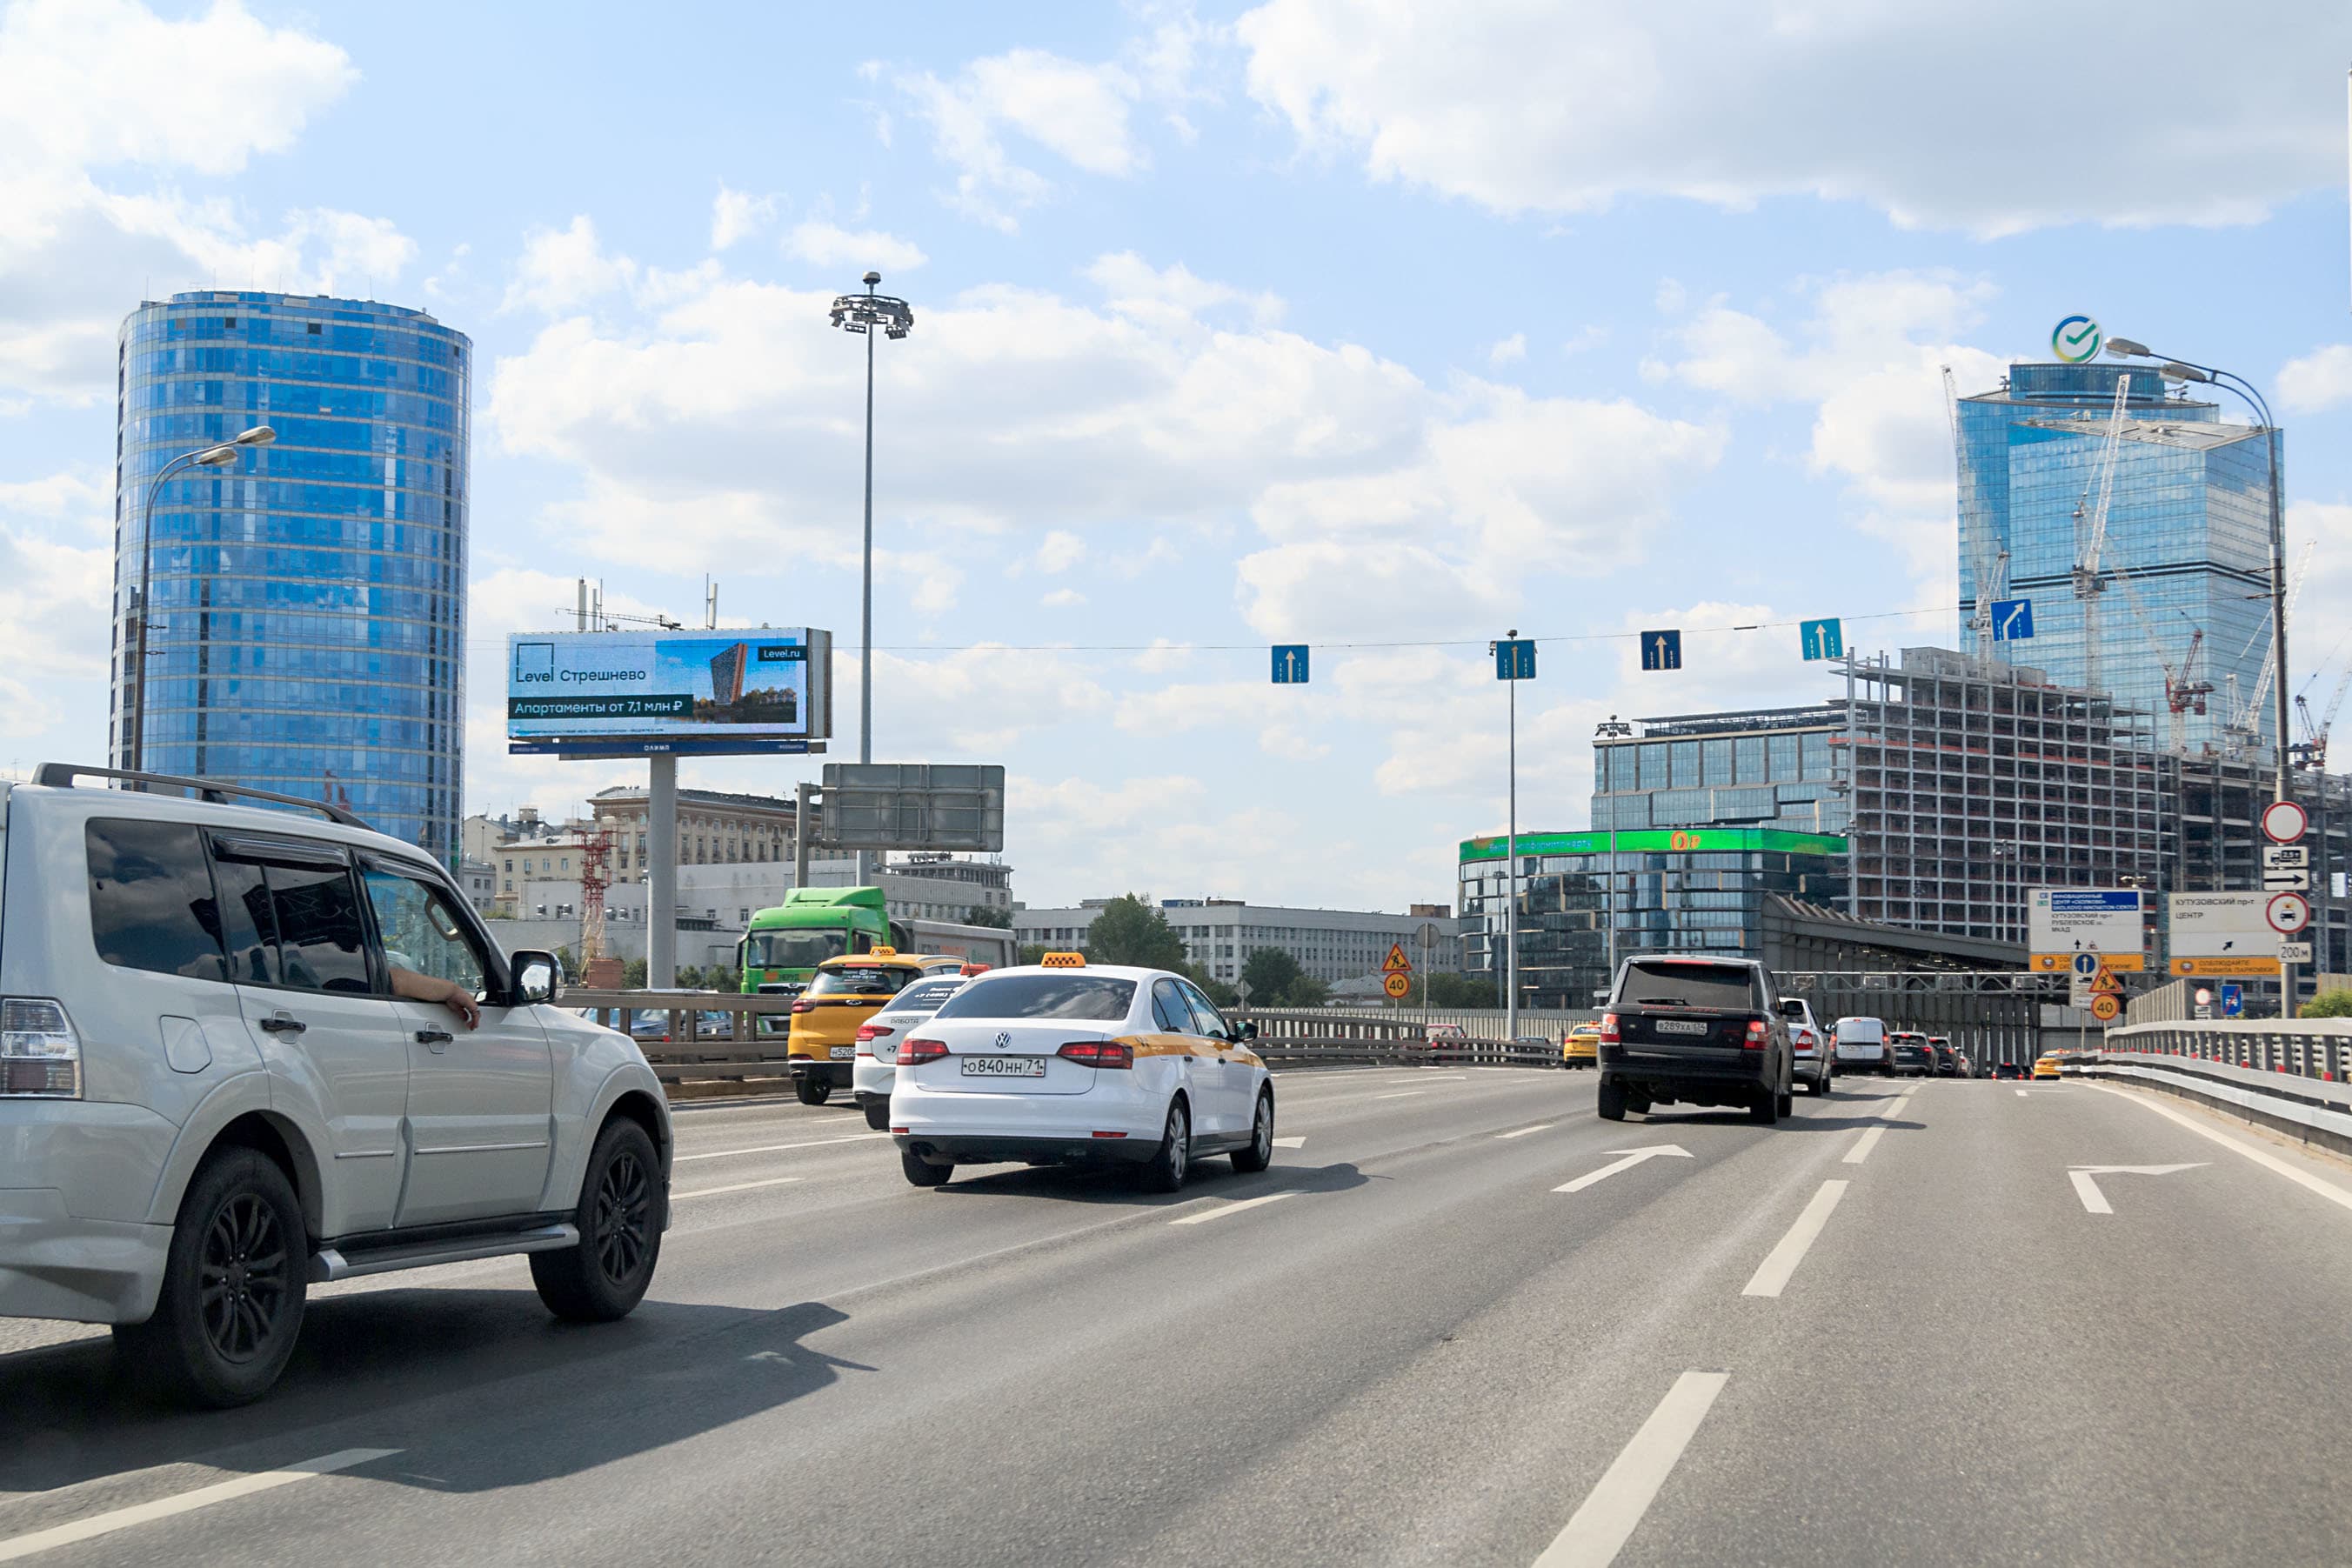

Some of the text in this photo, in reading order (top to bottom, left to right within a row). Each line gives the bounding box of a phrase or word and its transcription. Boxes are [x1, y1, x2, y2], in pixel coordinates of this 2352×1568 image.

[763, 649, 800, 658] Level.ru
[516, 666, 646, 685] Level Стрешнево
[514, 701, 605, 717] Апартаменты
[609, 701, 625, 712] от
[626, 700, 641, 714] 7,1
[645, 701, 671, 712] млн
[2175, 897, 2235, 905] КУТУЗОВСКИЙ
[2175, 911, 2203, 920] ЦЕНТР
[2281, 946, 2299, 958] 200
[1389, 979, 1404, 991] 40
[2096, 1002, 2114, 1013] 40
